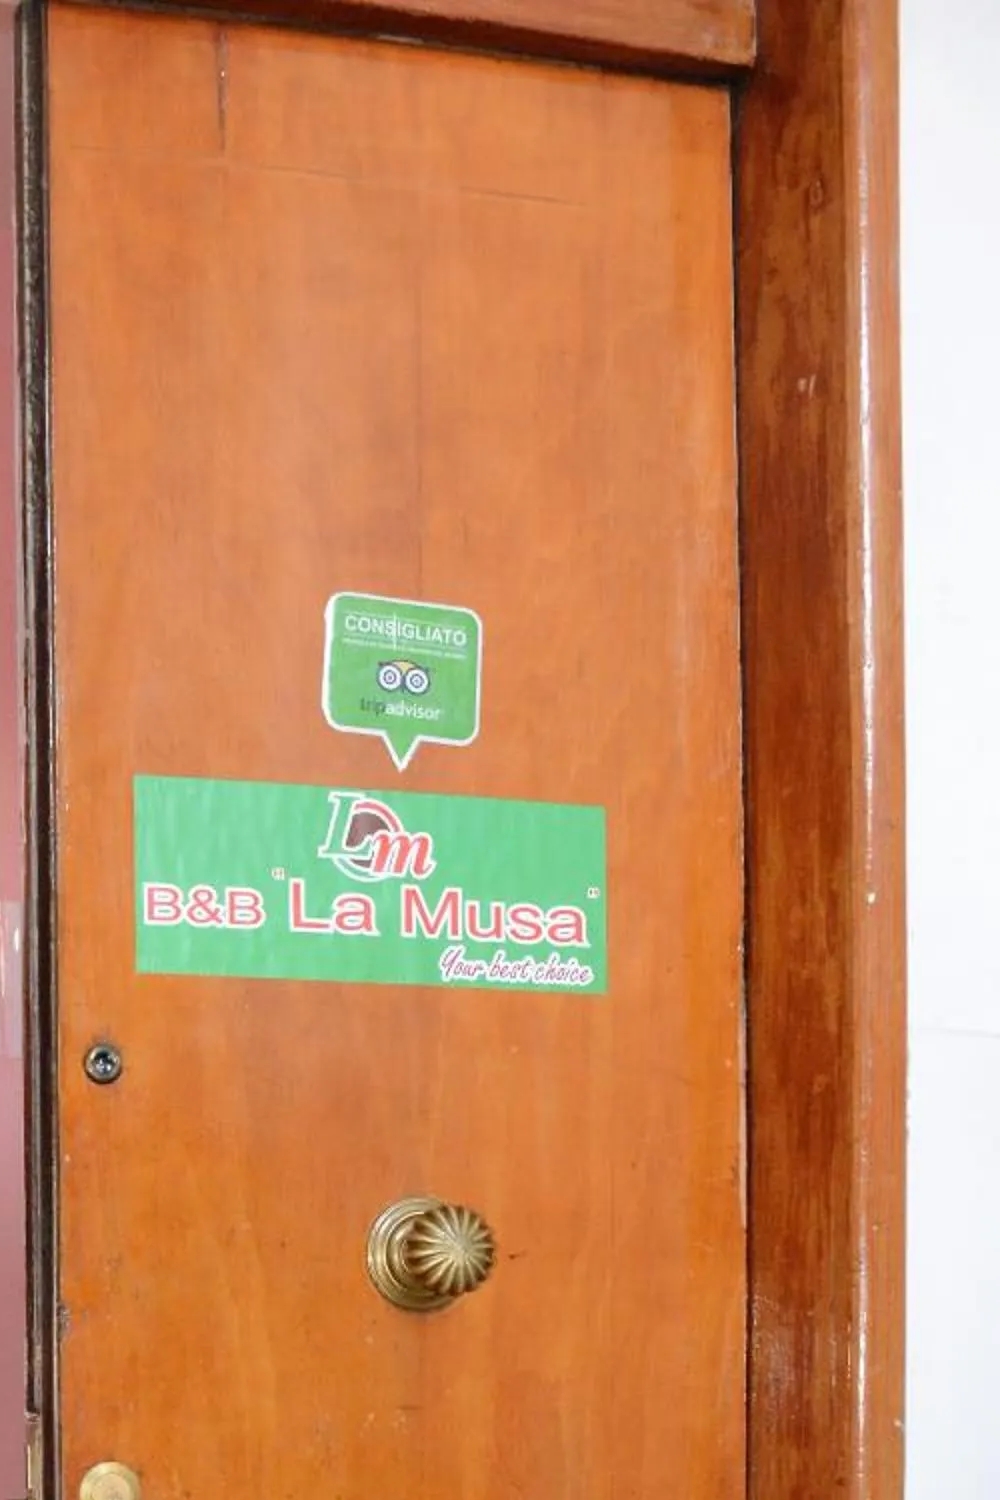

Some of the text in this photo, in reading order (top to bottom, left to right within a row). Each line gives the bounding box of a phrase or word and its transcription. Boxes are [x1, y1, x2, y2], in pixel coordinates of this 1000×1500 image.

[344, 614, 467, 647] CONSIGLIATO
[144, 882, 265, 929] B&B
[439, 946, 593, 986] Your best choice
